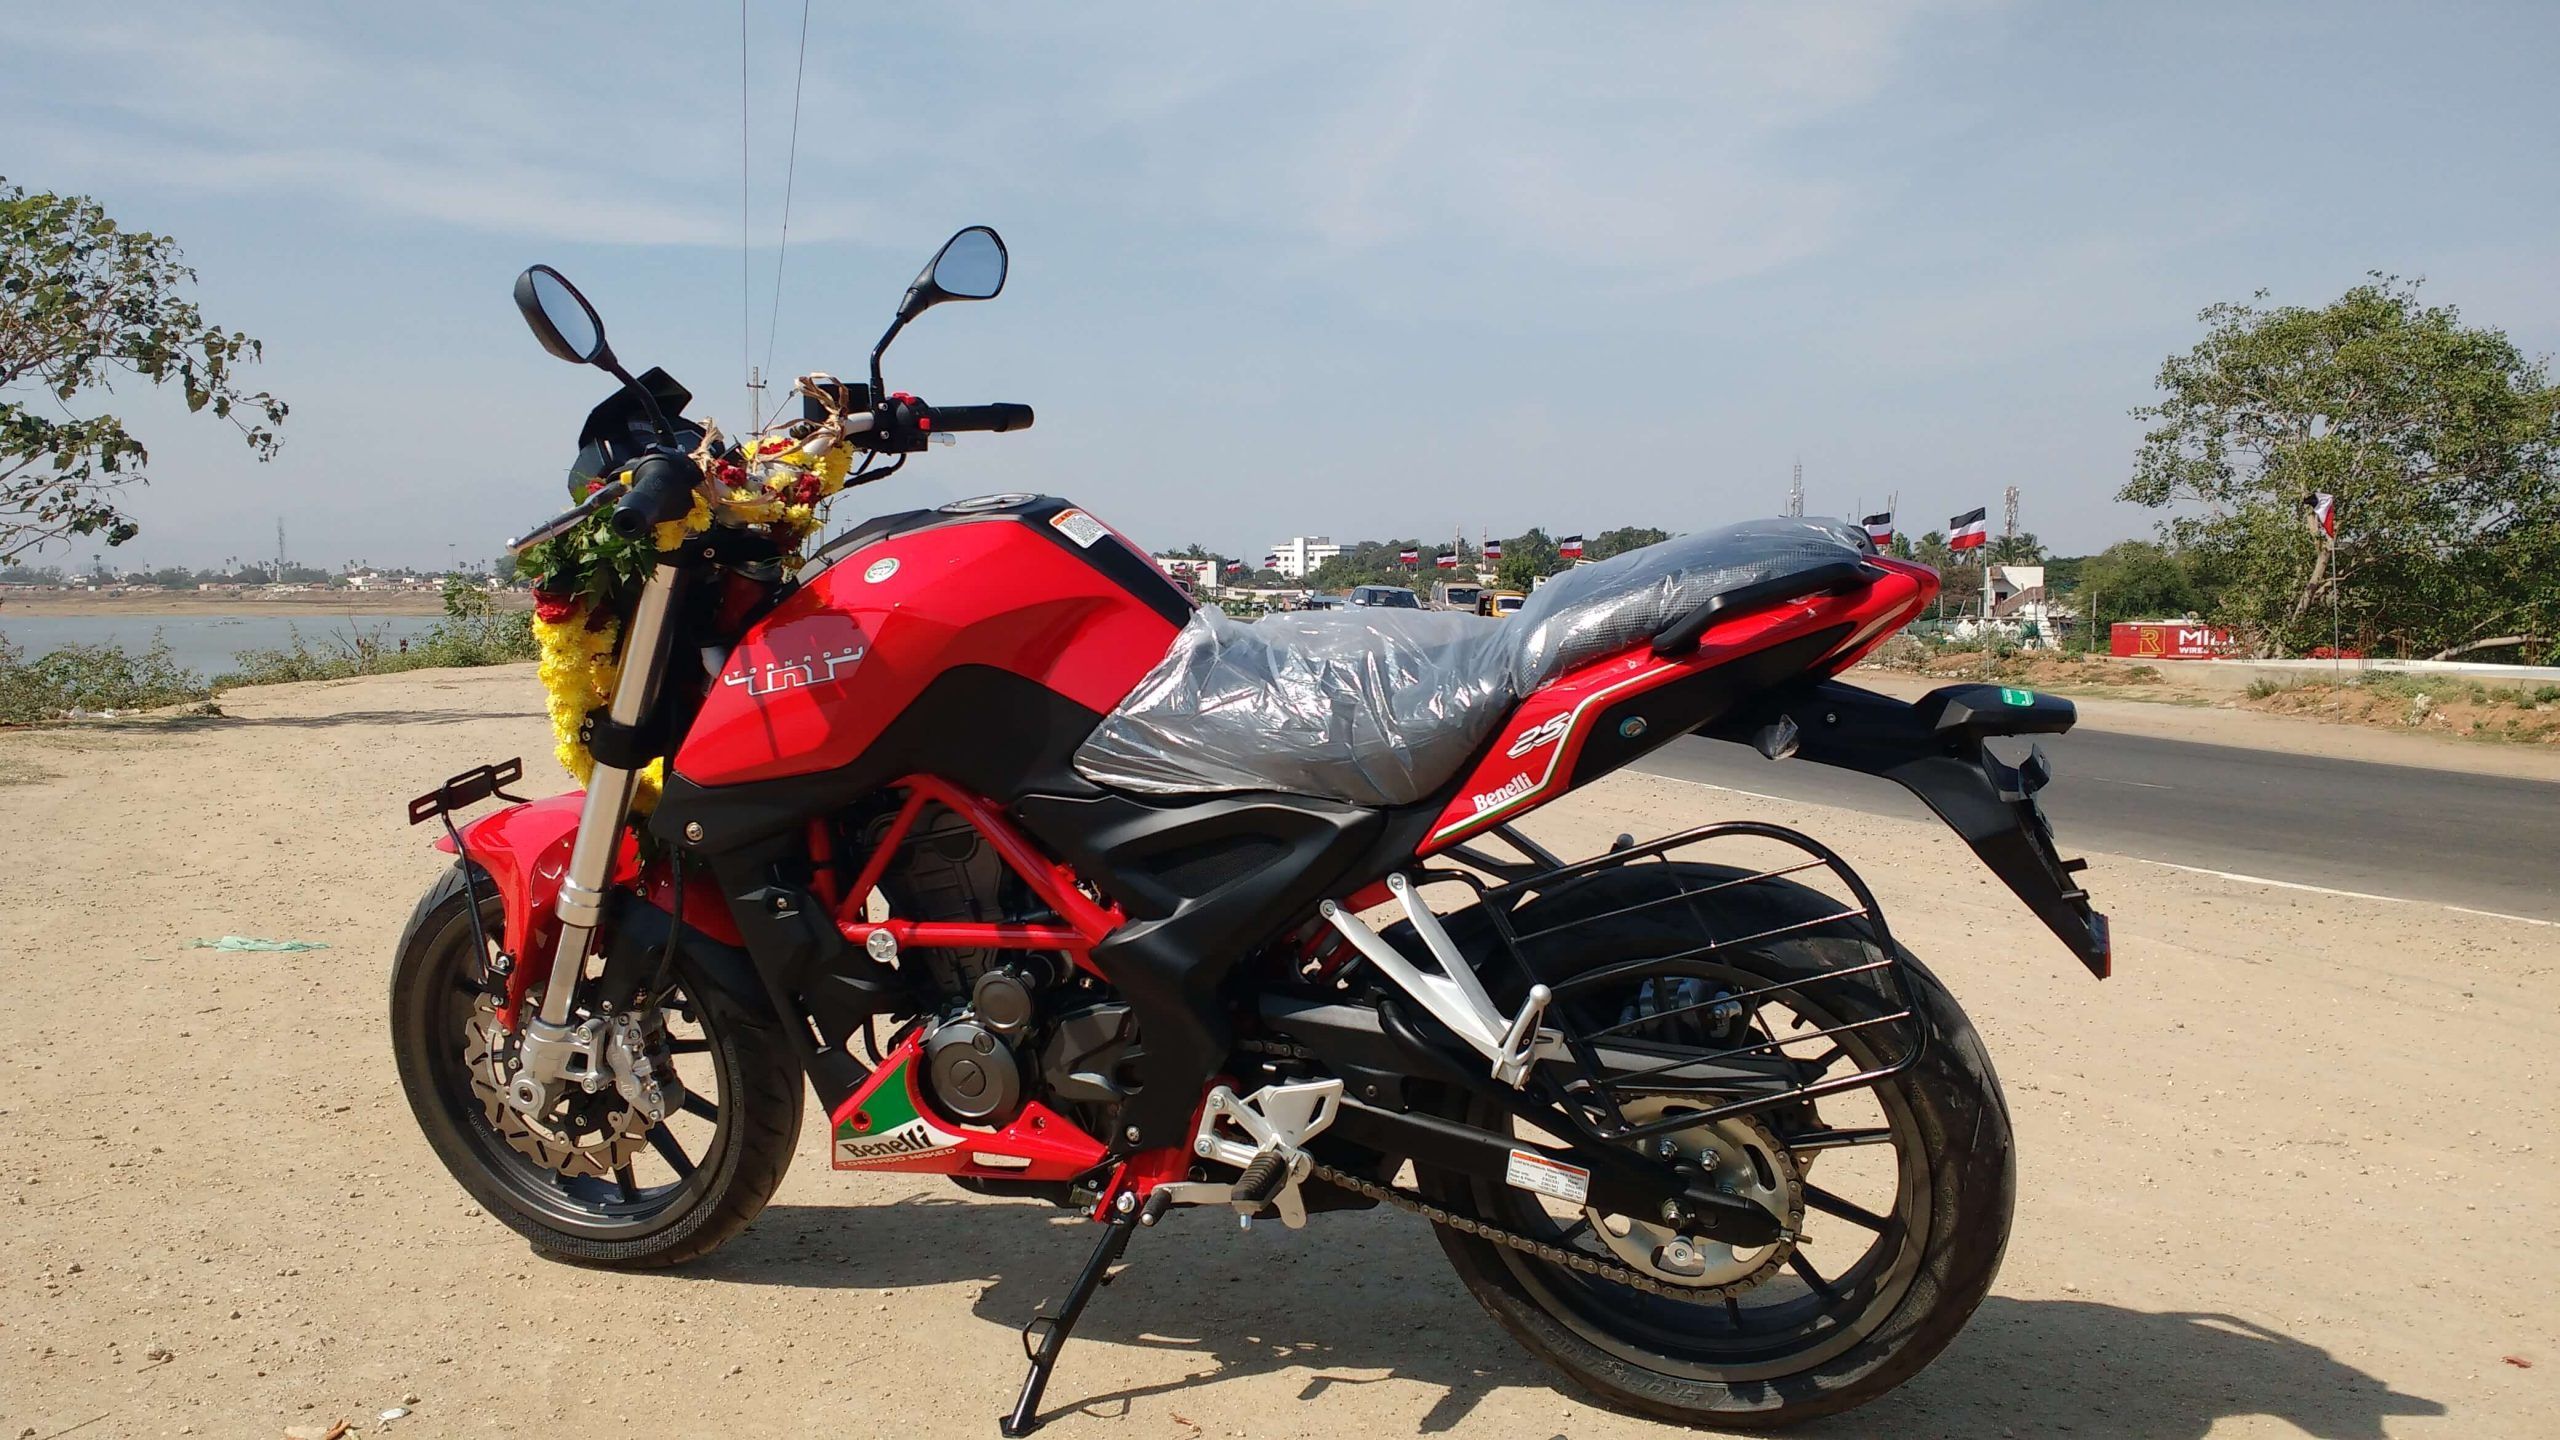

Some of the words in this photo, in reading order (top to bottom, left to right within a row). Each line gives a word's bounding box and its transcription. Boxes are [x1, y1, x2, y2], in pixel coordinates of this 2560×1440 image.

[732, 647, 852, 678] TORNADO
[1507, 711, 1571, 759] 25
[1472, 772, 1535, 812] Benelli
[840, 1156, 906, 1168] TORNADO
[908, 1147, 957, 1161] NAKED
[841, 1124, 935, 1158] Benelli
